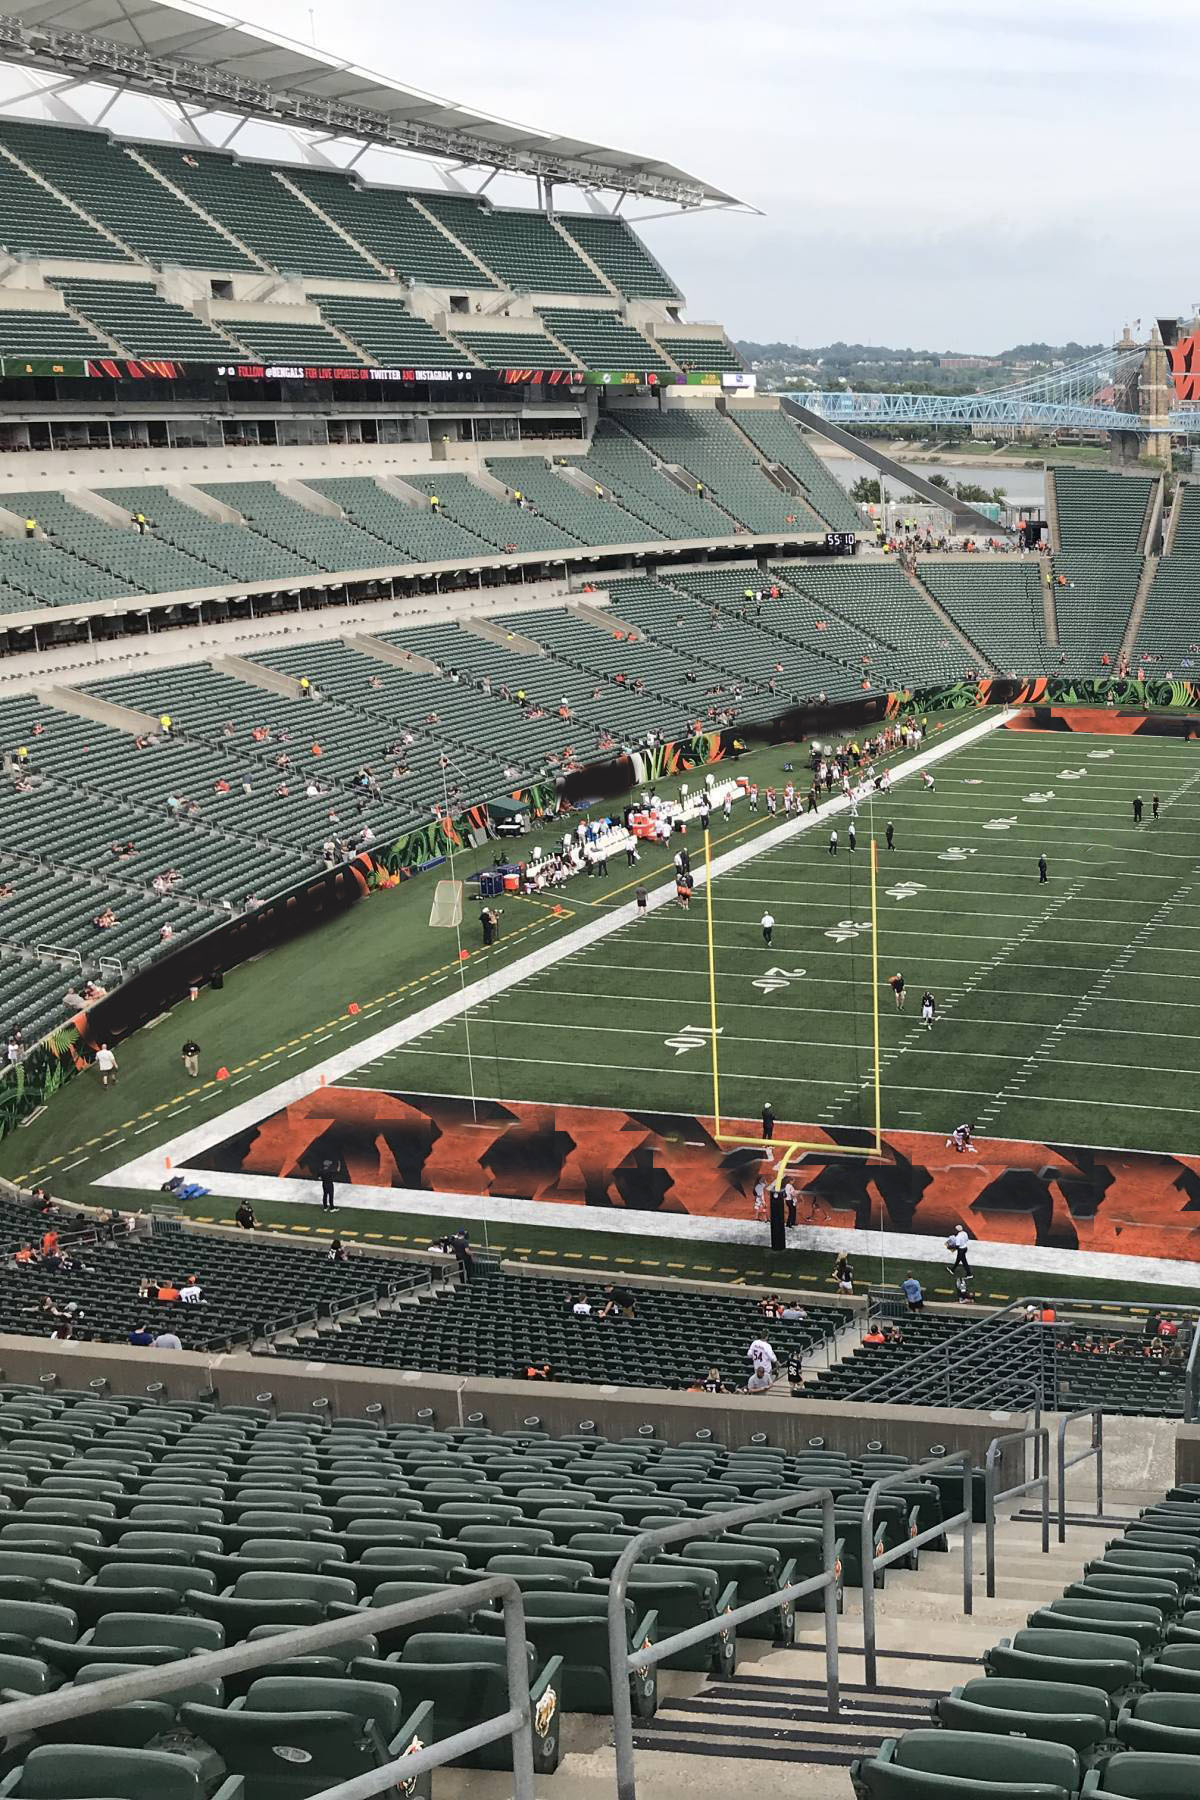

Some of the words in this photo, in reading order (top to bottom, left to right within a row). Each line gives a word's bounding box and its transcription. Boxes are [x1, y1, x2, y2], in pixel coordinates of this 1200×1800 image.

[238, 366, 264, 377] FOLLOW
[265, 366, 304, 378] @BENGALS
[370, 369, 400, 380] TWITTER
[415, 370, 452, 381] INSTAGRAM
[828, 534, 854, 545] 55:10
[937, 846, 979, 860] 50
[824, 920, 872, 938] 30
[752, 967, 806, 988] 20
[664, 1025, 724, 1048] 10
[753, 1349, 763, 1362] 54
